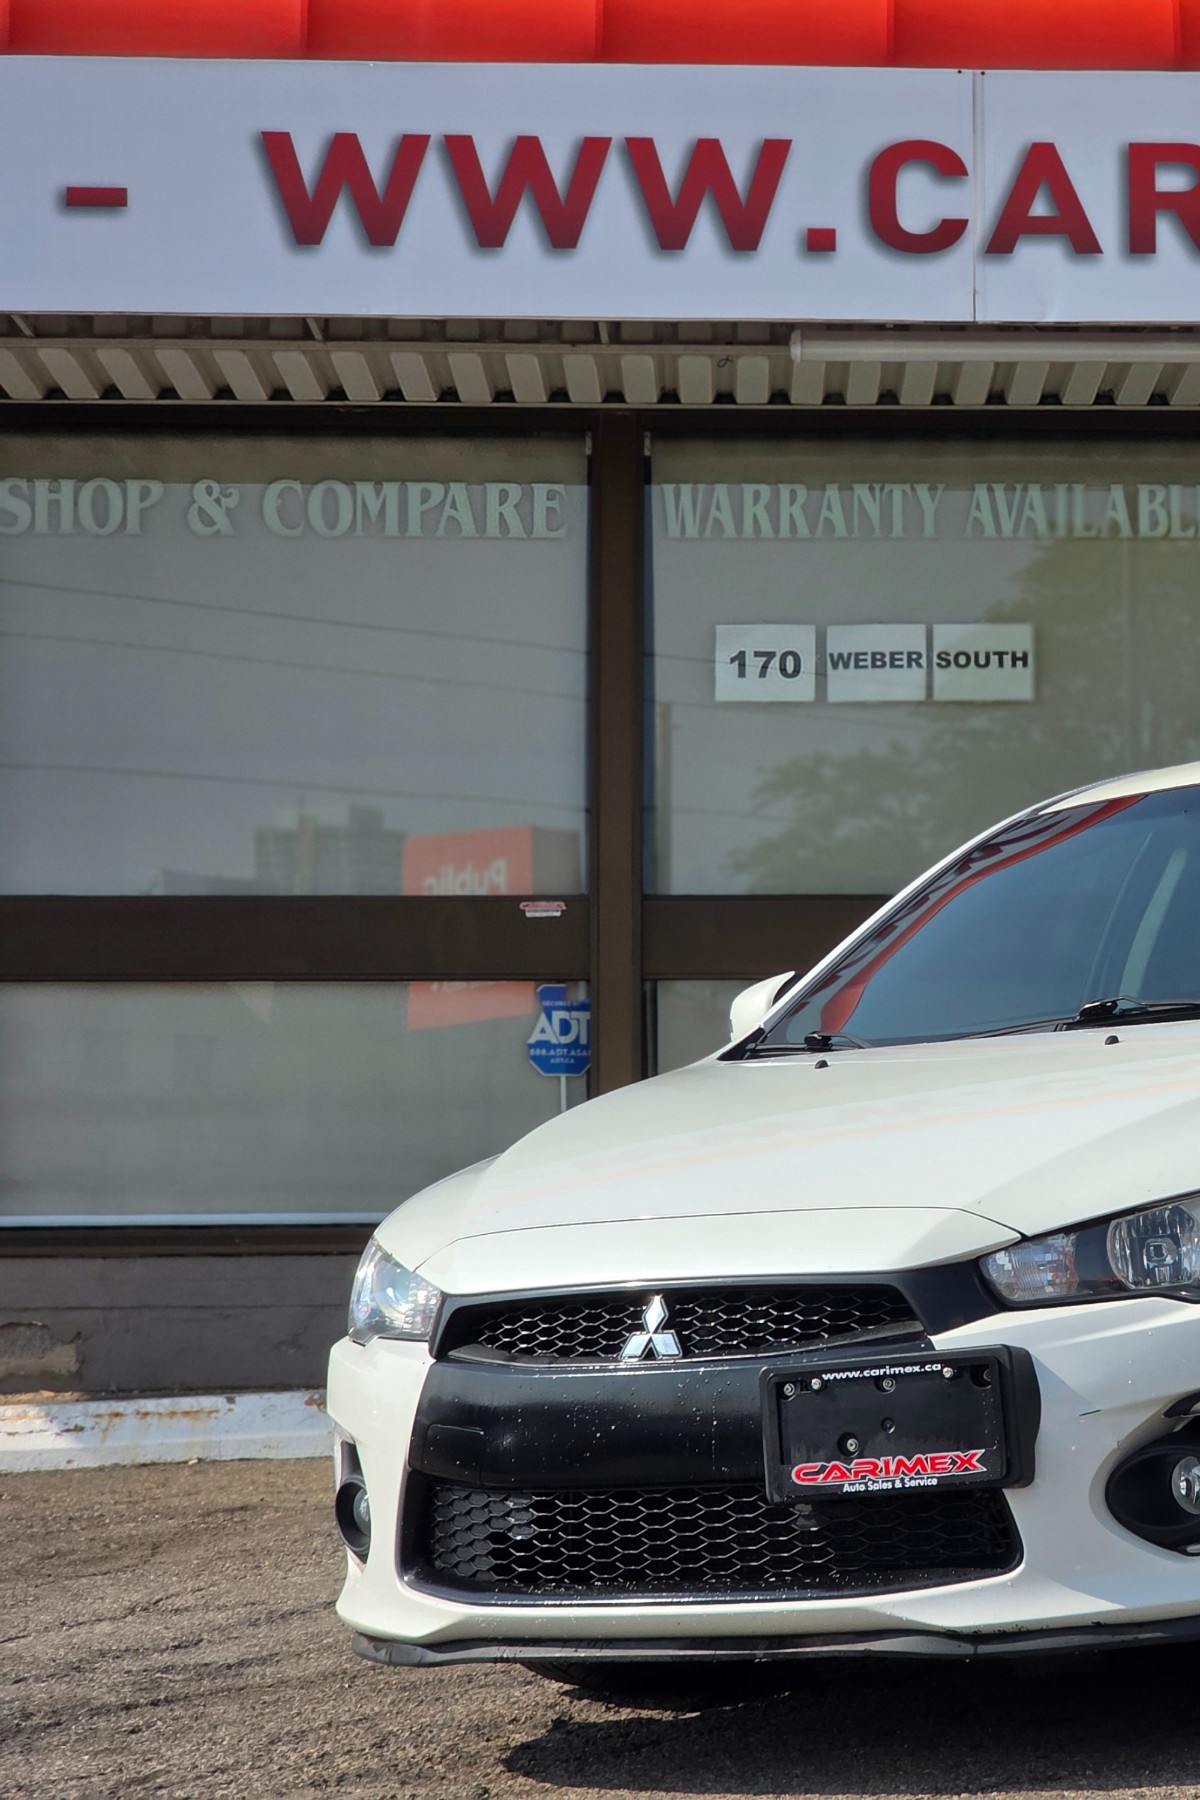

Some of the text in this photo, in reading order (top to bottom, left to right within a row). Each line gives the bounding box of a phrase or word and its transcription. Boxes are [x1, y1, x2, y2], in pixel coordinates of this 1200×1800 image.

[0, 477, 568, 539] SHOP & COMPARE
[661, 483, 945, 539] WARRANTY
[729, 650, 1030, 679] 170 WEBER SOUTH
[527, 1010, 591, 1045] ADT
[822, 1364, 942, 1381] www.carimex.ca
[792, 1449, 986, 1485] CARIMEX
[843, 1476, 938, 1493] Auto Sales & Service
